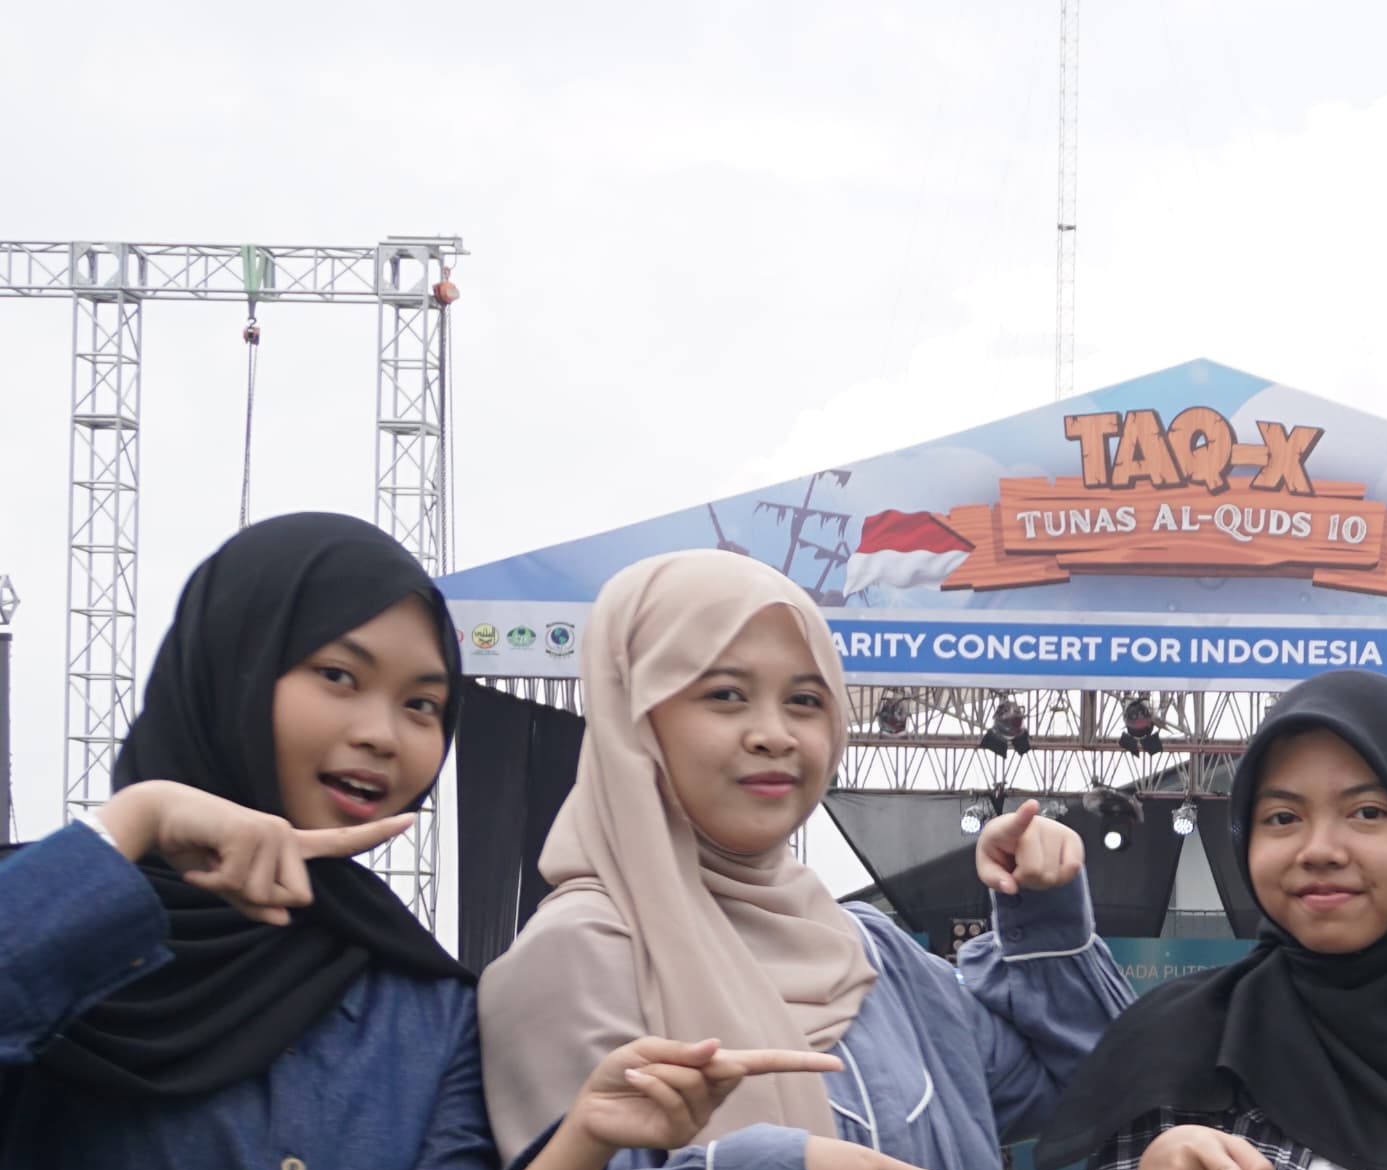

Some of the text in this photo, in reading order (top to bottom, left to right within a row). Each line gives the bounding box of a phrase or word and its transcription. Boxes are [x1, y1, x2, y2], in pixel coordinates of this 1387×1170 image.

[1064, 405, 1325, 496] TAQ-X
[1016, 503, 1368, 544] TUNAS AL-QUDS 10
[932, 633, 1102, 662] CONCERT
[1110, 636, 1181, 663] FOR
[1190, 638, 1383, 667] INDONESIA
